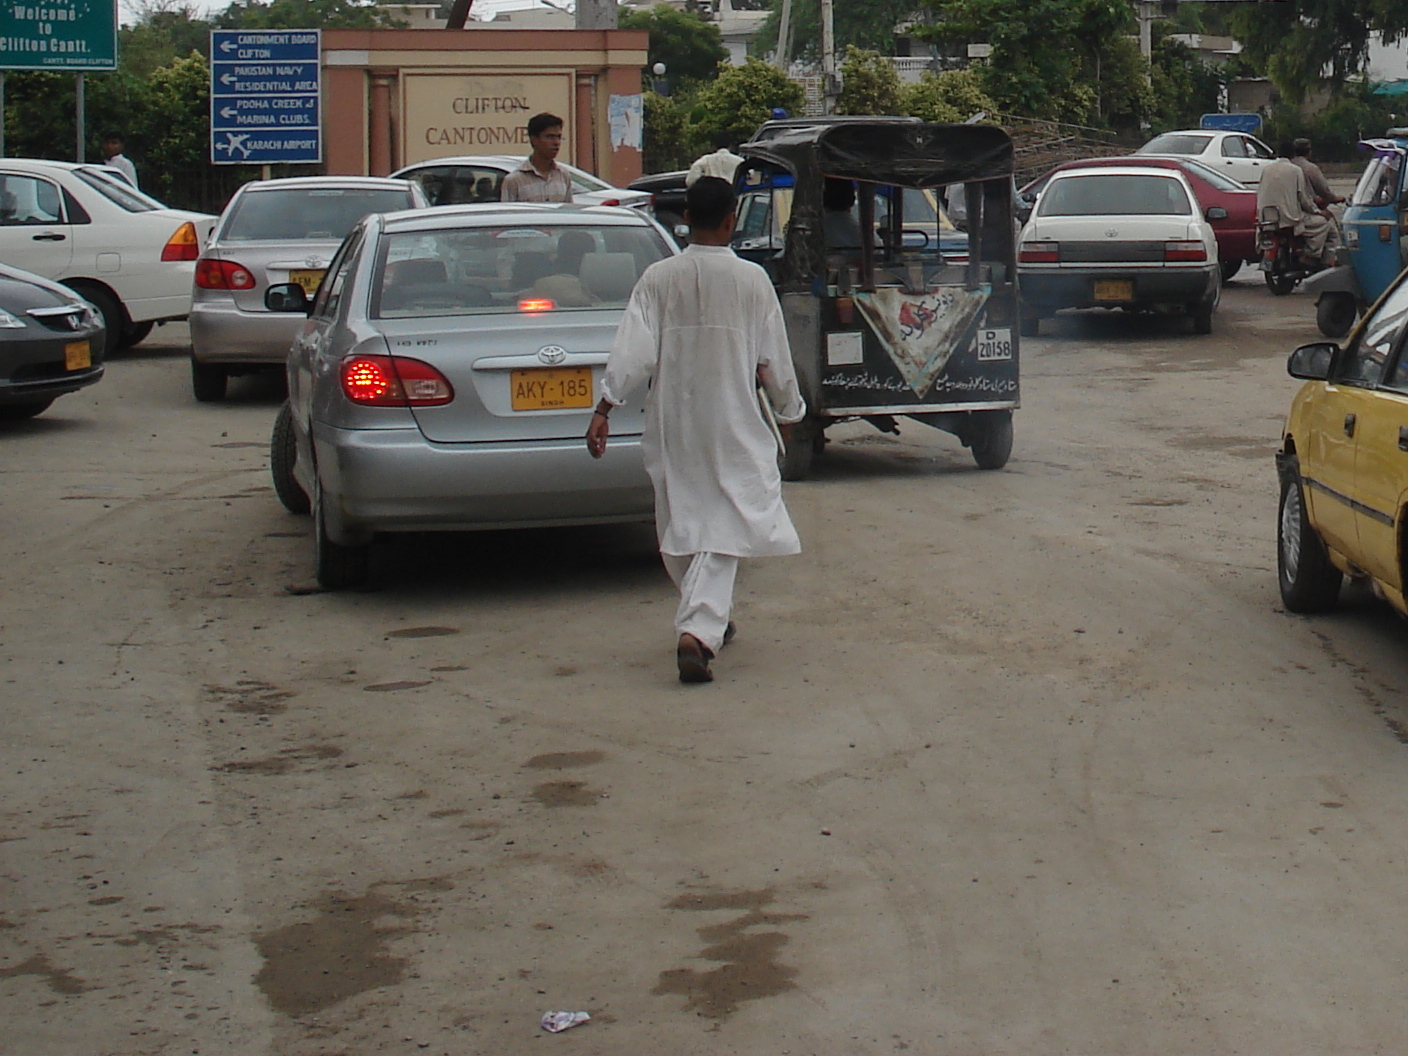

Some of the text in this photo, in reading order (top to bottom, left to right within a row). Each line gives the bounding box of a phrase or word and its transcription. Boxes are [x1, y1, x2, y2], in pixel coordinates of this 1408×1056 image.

[14, 5, 76, 21] Welcome
[38, 22, 52, 35] to
[238, 35, 316, 44] CANTONMENT BOARD
[0, 37, 91, 53] Clifton Cantt.
[238, 49, 270, 58] CLIFTON
[234, 66, 303, 75] PAKISTAN NAVY
[235, 82, 318, 91] RESIDENTIAL AREA
[272, 99, 303, 108] CREEK
[452, 97, 527, 115] CLIFTON
[237, 114, 311, 124] MARINA CLUBS.
[425, 126, 529, 145] CANTONME
[247, 140, 316, 149] KARACHI AIRPORT
[985, 331, 996, 340] D
[979, 340, 1010, 357] 20158
